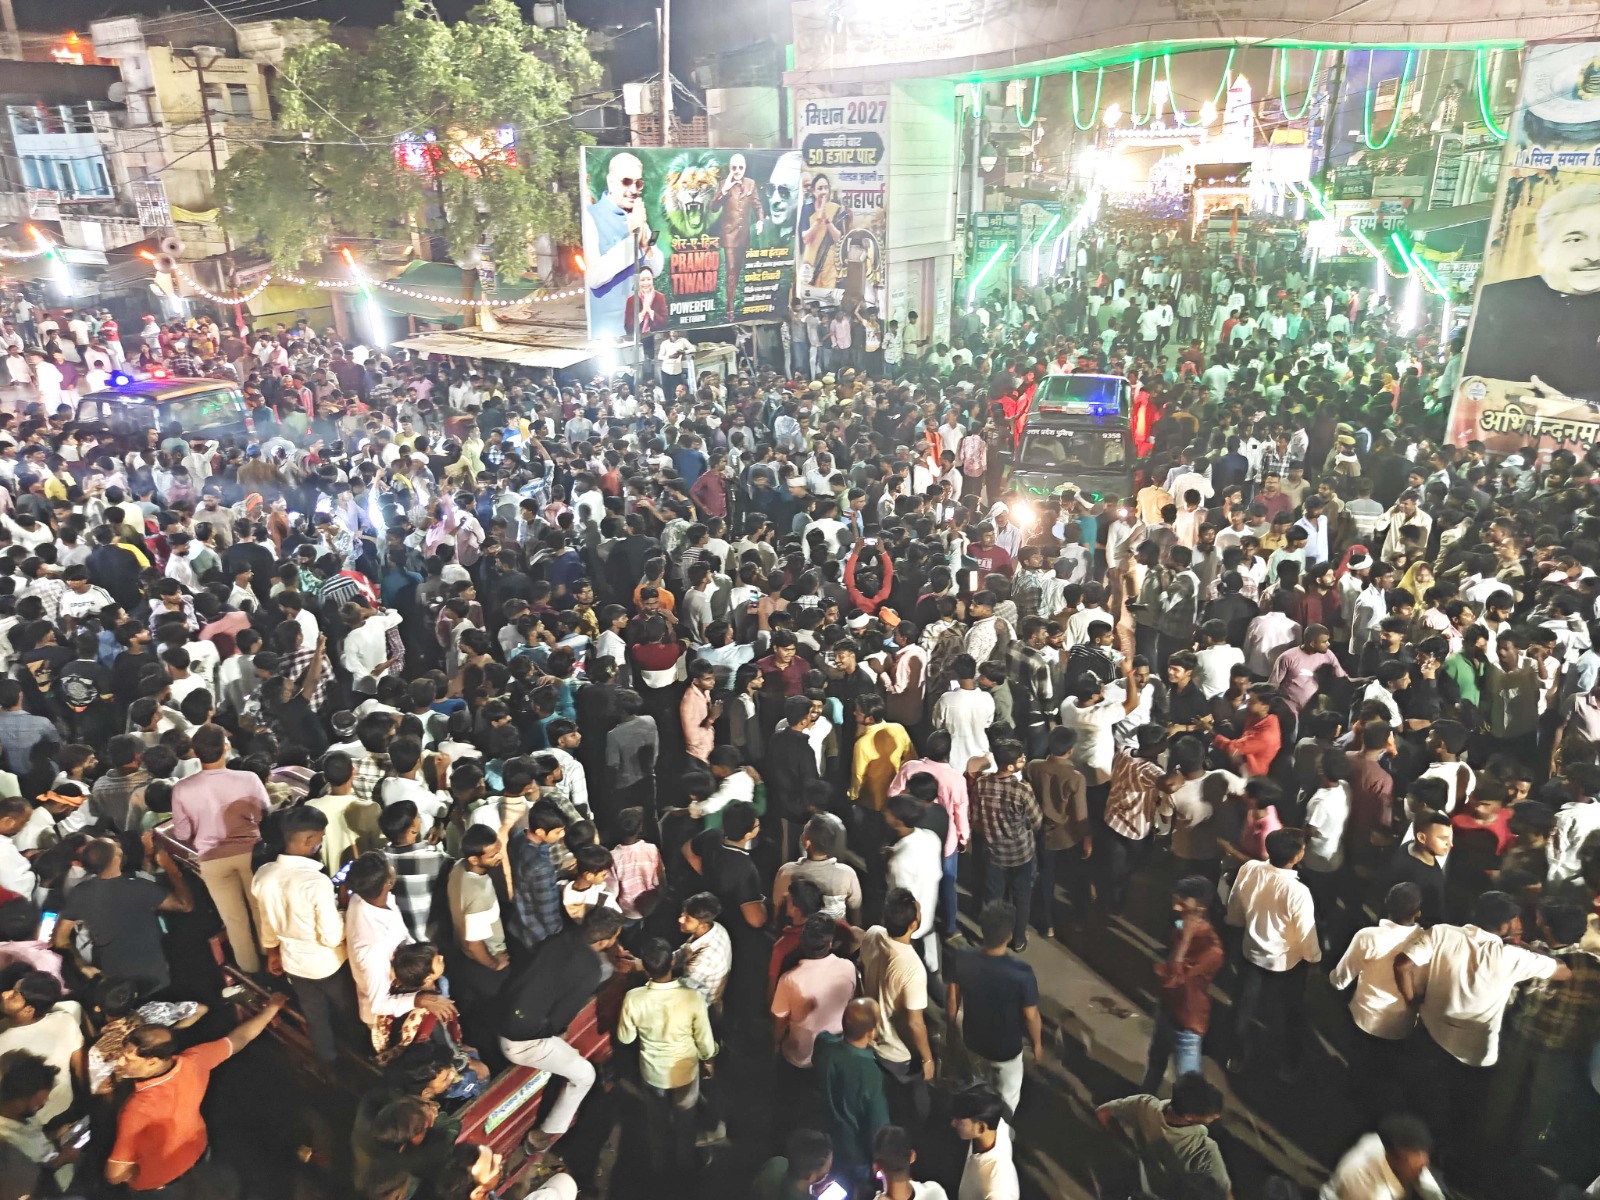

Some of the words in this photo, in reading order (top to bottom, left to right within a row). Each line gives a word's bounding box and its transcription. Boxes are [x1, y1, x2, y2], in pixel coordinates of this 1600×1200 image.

[805, 103, 844, 126] मिशन
[847, 101, 887, 125] 2027
[808, 148, 824, 165] 50
[825, 147, 854, 164] हजार
[855, 147, 877, 165] पार
[1557, 153, 1590, 166] समान
[841, 182, 886, 209] महापर्व
[670, 250, 720, 274] PRAMOD
[671, 270, 718, 296] TIWARI
[669, 299, 716, 316] POWERFUL
